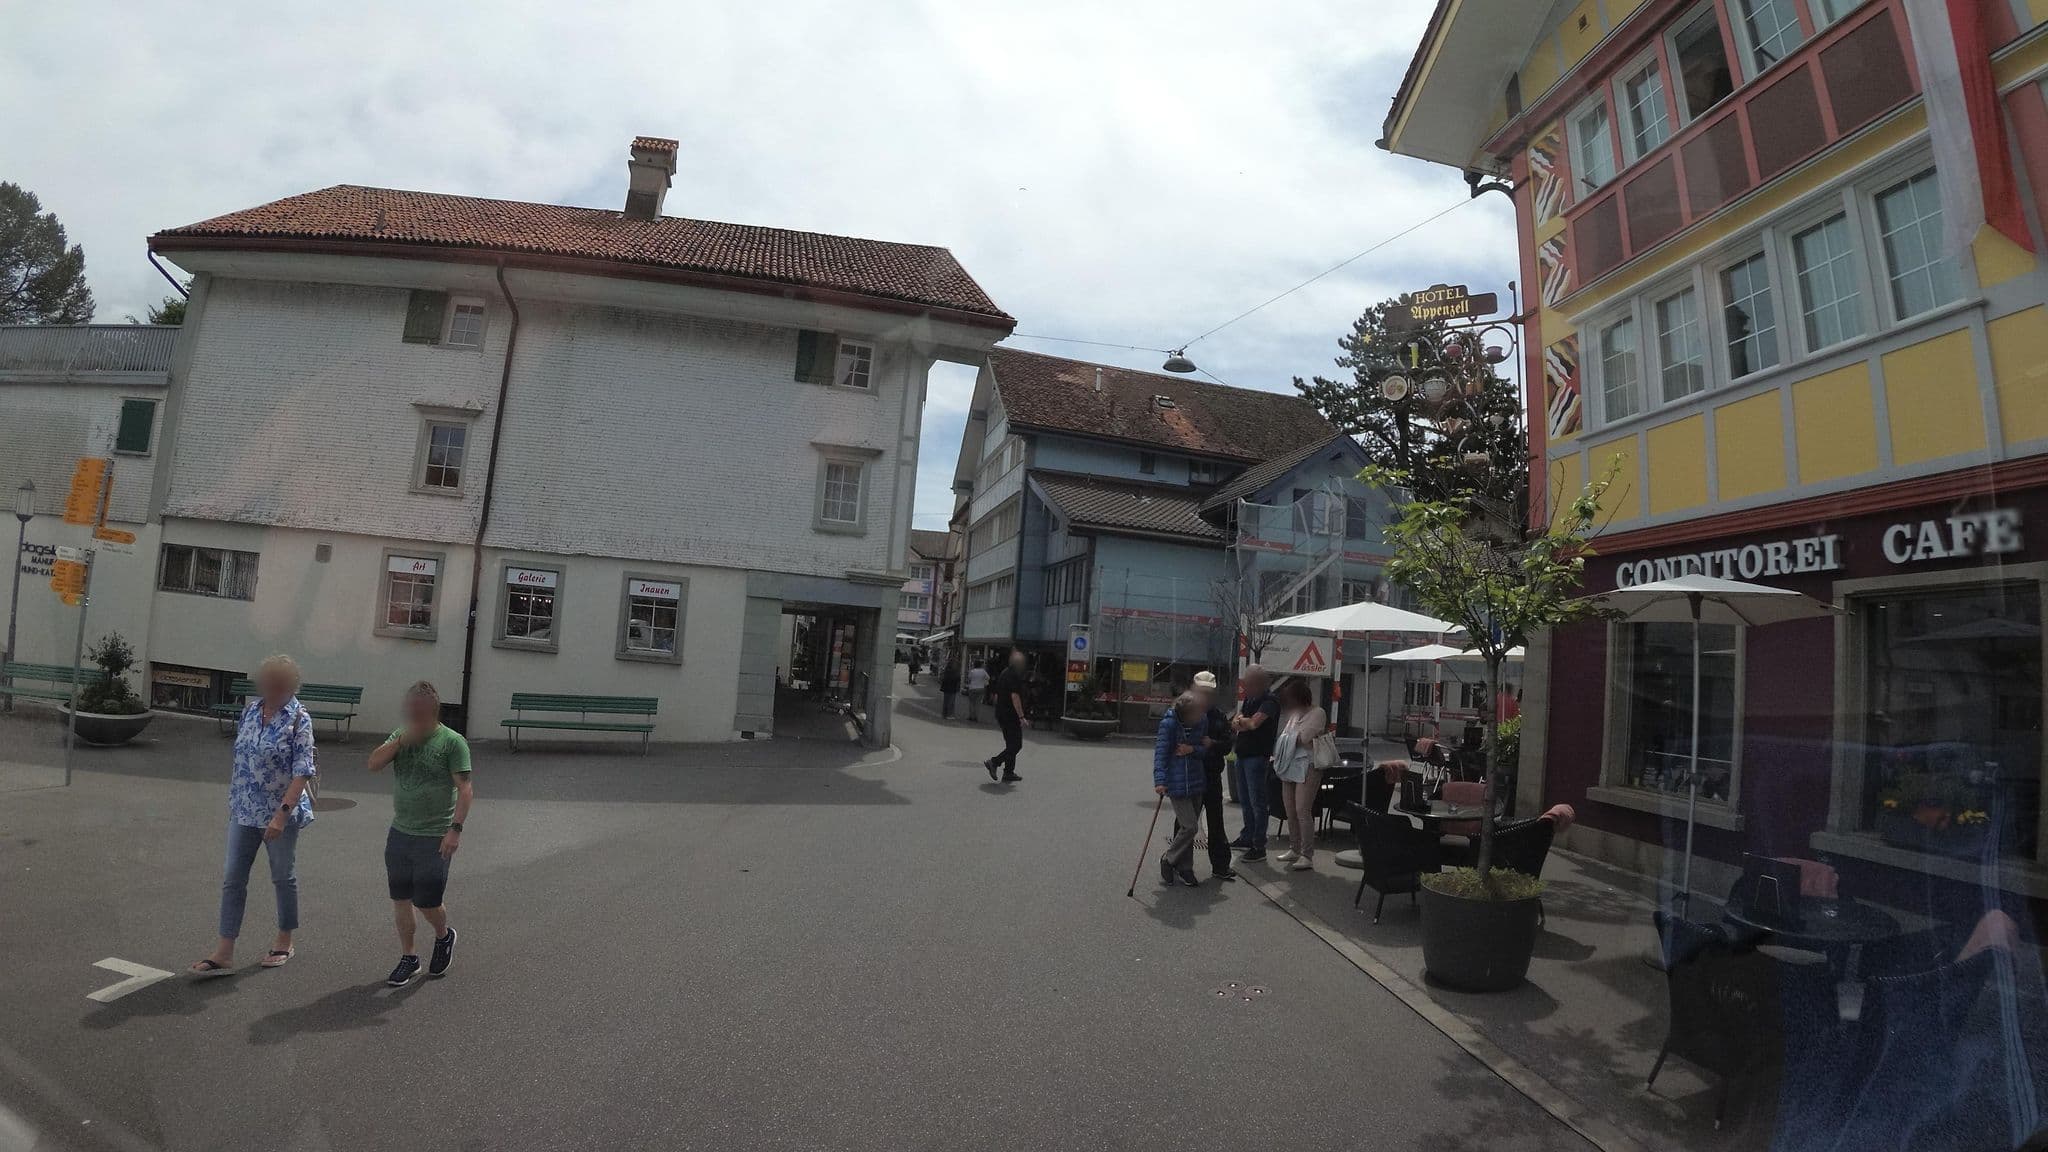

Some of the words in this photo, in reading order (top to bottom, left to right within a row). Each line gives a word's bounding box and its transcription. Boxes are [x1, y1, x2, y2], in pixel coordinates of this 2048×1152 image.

[1415, 287, 1464, 304] HOTEL
[1410, 299, 1469, 320] Appenzell
[31, 555, 57, 566] MANUF
[412, 559, 427, 573] Art
[1616, 534, 1840, 590] CONDITOREI
[21, 565, 56, 577] HUND-KAT
[518, 571, 547, 584] Galerie
[639, 583, 670, 595] Inauen
